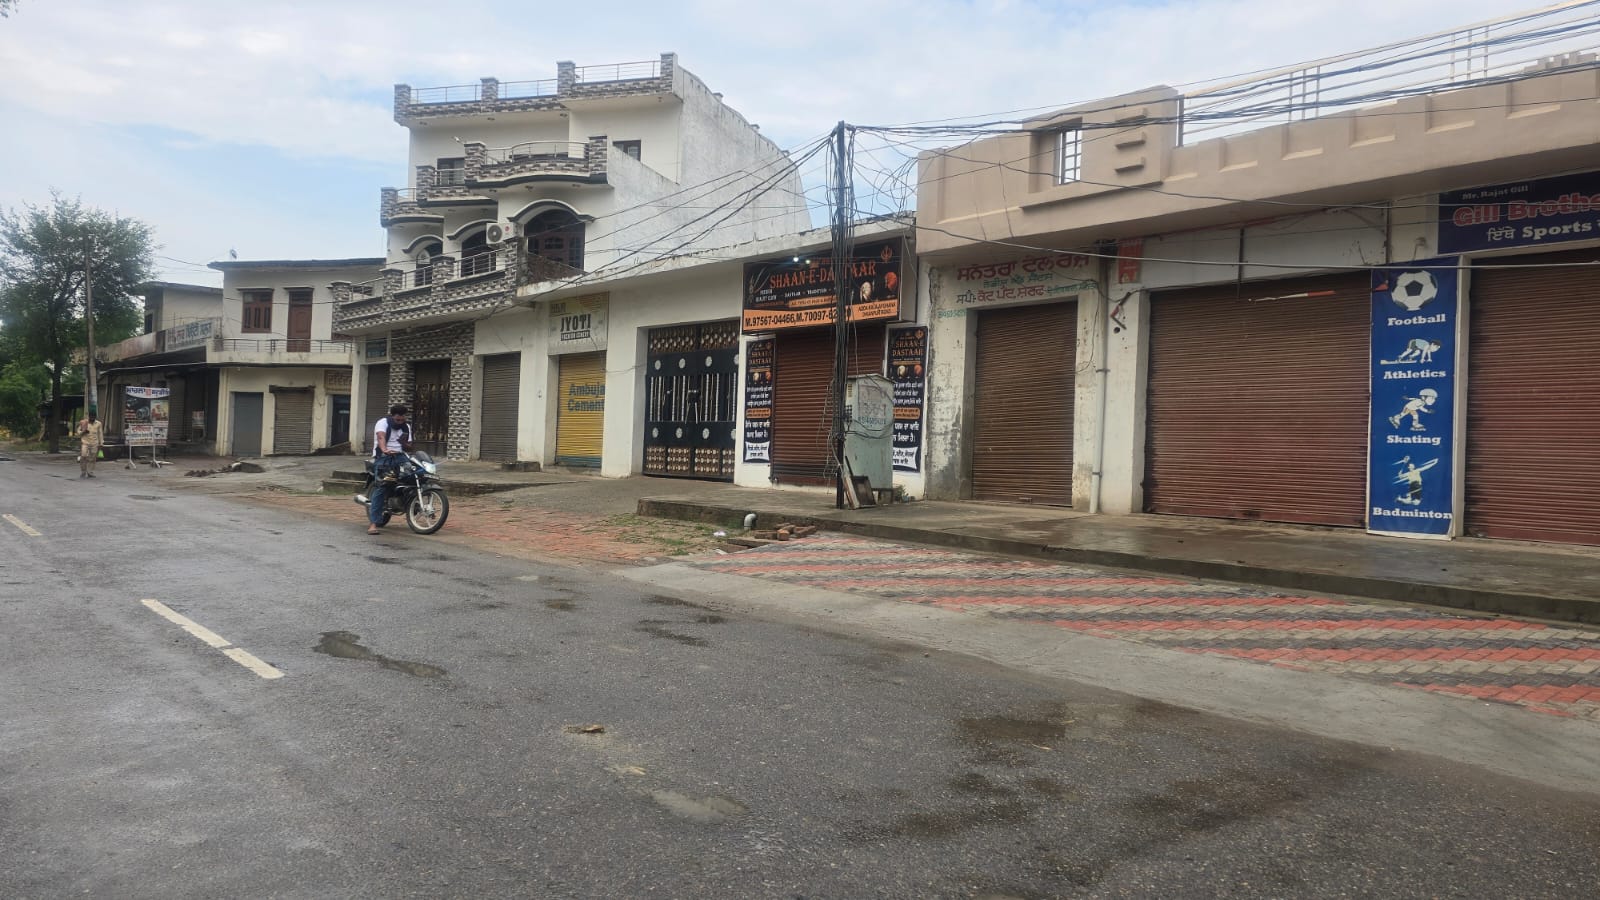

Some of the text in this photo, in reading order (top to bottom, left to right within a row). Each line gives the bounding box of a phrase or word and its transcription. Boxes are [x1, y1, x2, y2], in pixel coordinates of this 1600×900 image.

[1462, 191, 1480, 200] Mr.
[1453, 204, 1500, 226] Gill
[1522, 220, 1593, 240] Sports
[560, 314, 592, 332] JYOTI
[1387, 314, 1447, 327] Football
[1383, 369, 1447, 380] Athletics
[1386, 435, 1441, 446] Skating
[1372, 507, 1453, 520] Badminton
